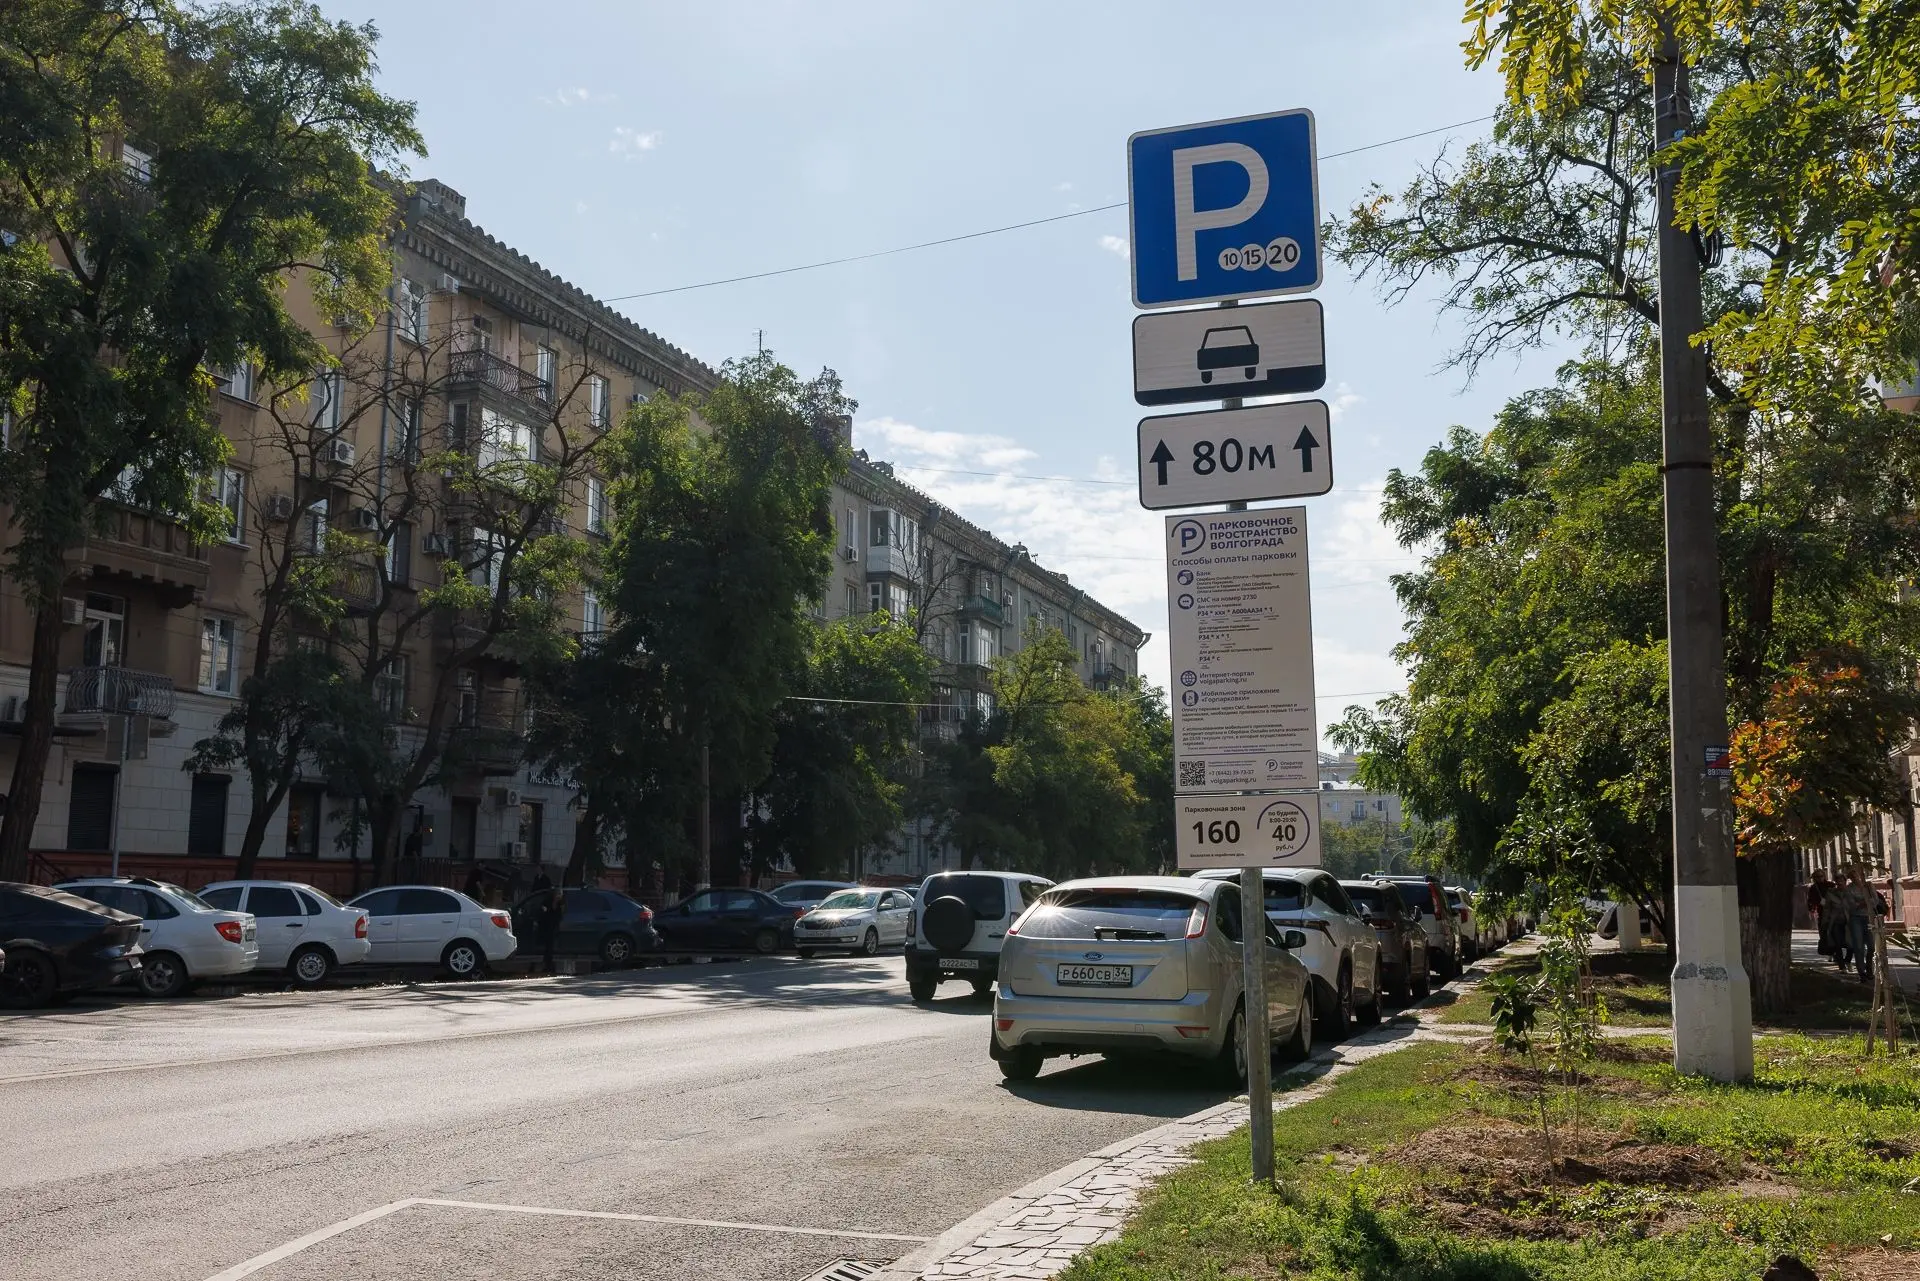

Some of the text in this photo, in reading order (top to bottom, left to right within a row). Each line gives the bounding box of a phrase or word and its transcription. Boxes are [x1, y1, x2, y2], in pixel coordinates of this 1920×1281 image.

[1173, 142, 1269, 282] P
[1223, 242, 1298, 266] 10 15 20
[1210, 517, 1293, 530] ПАРКОВОЧНОЕ
[1181, 528, 1197, 547] P
[1210, 526, 1298, 540] ПРОСТРАНСТВО
[1210, 537, 1284, 550] ВОЛГОГРАДА
[1172, 552, 1297, 566] Способы оплаты парковки
[1199, 671, 1255, 679] Интернет-портал
[1184, 806, 1228, 814] Парковочная
[1192, 820, 1240, 844] 160
[1272, 824, 1296, 842] 40
[1063, 967, 1111, 980] Р660СВ
[1115, 967, 1127, 978] 34
